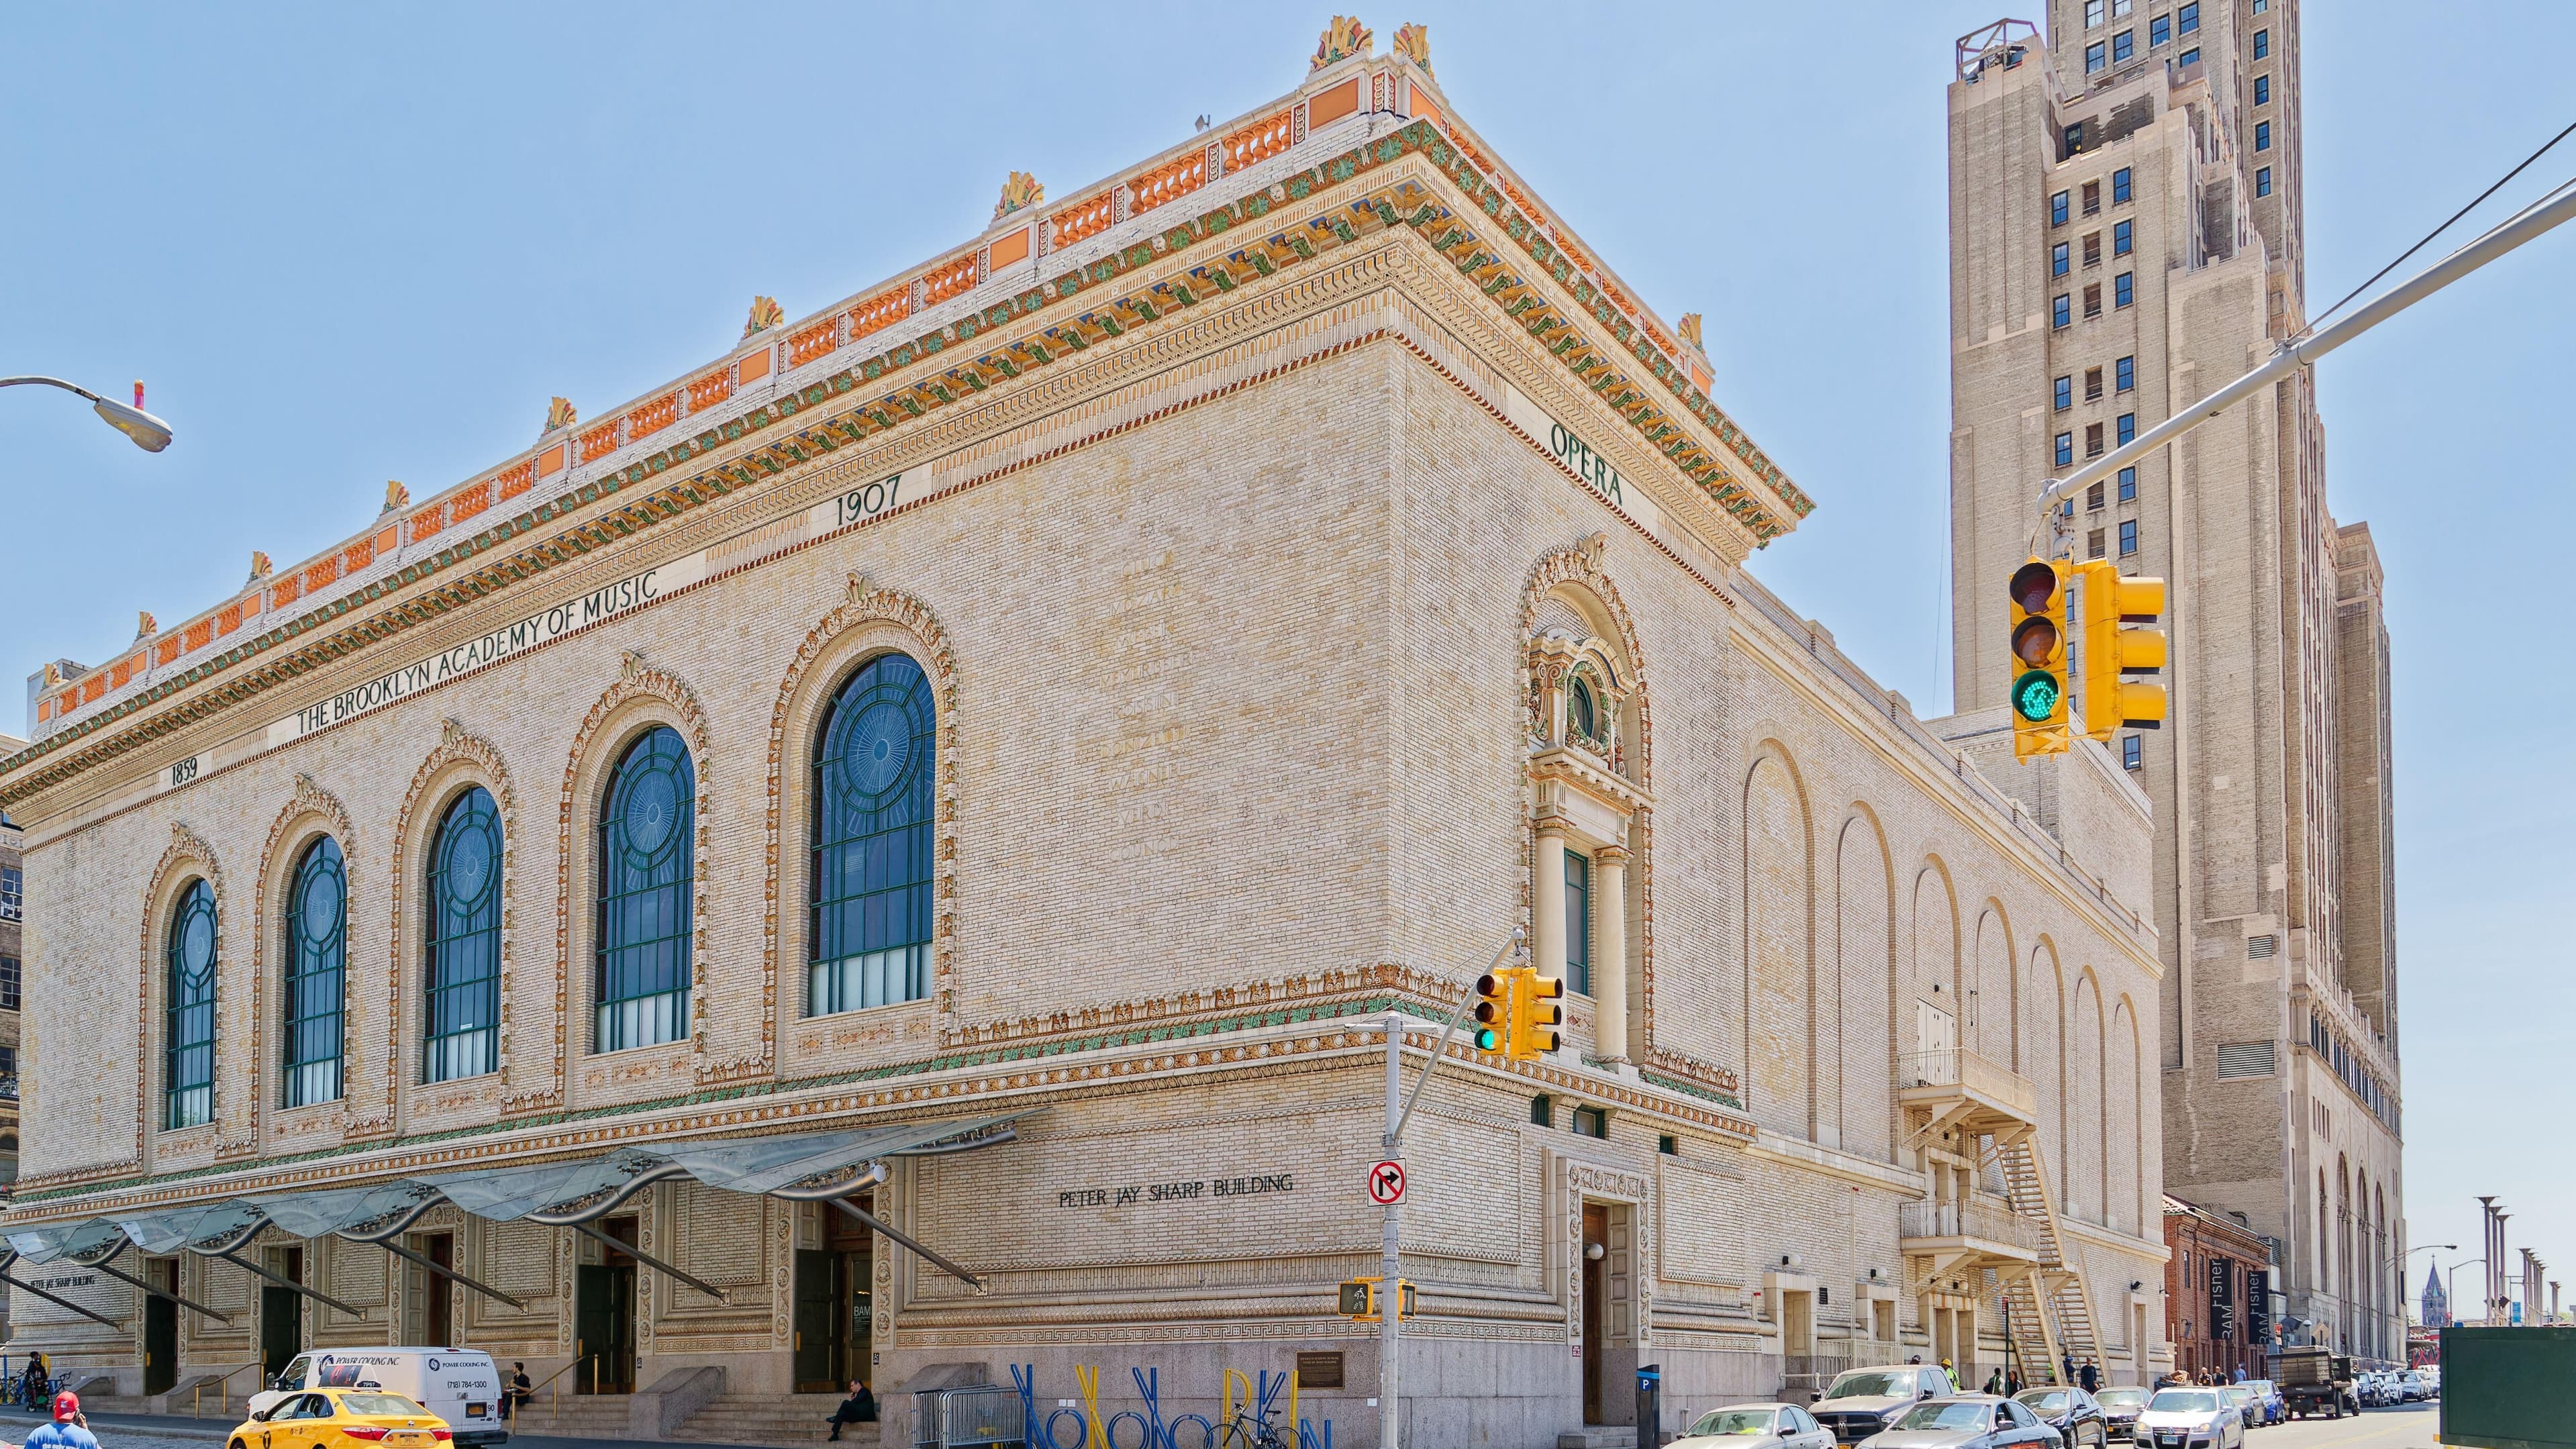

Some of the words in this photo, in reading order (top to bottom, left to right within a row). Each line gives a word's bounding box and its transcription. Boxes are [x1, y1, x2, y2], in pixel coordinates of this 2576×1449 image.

[1551, 423, 1622, 506] OPERA
[837, 474, 903, 526] 1907
[297, 700, 329, 734] THE
[334, 661, 430, 719] BROOKLYN
[438, 614, 542, 680] ACADEMY
[548, 603, 577, 635] OF
[583, 570, 658, 623] MUSIC
[172, 757, 198, 787] 1859
[1060, 1190, 1107, 1207] PETER
[1116, 1187, 1141, 1207] JAY
[1148, 1182, 1204, 1201] SHARP
[1213, 1175, 1293, 1197] BUILDING
[854, 1305, 871, 1316] BAM
[358, 1357, 387, 1365] COOLING
[447, 1381, 460, 1389] (718)
[462, 1381, 487, 1389] 784-1300
[1642, 1379, 1649, 1389] P
